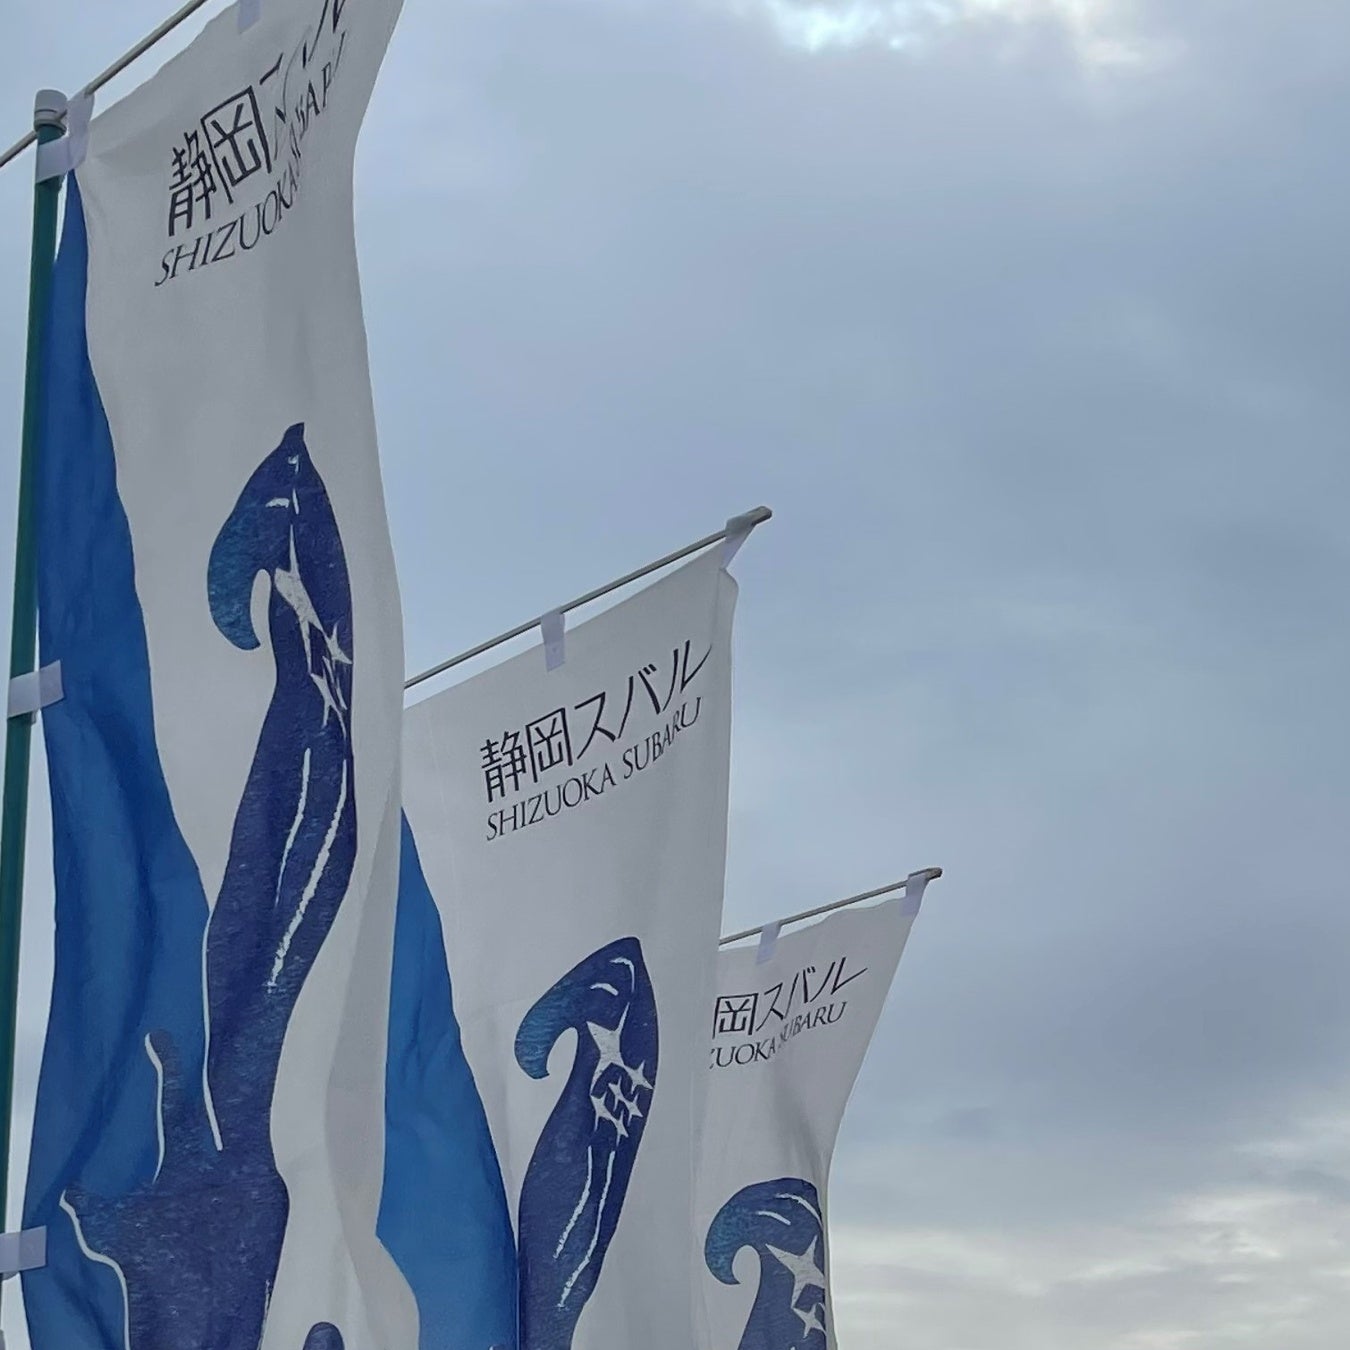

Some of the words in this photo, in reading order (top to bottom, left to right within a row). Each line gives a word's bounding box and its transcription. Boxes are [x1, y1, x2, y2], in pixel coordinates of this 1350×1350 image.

[479, 639, 712, 803] 静岡スバル
[486, 763, 617, 841] SHIZUOKA
[622, 696, 702, 780] SUBARU
